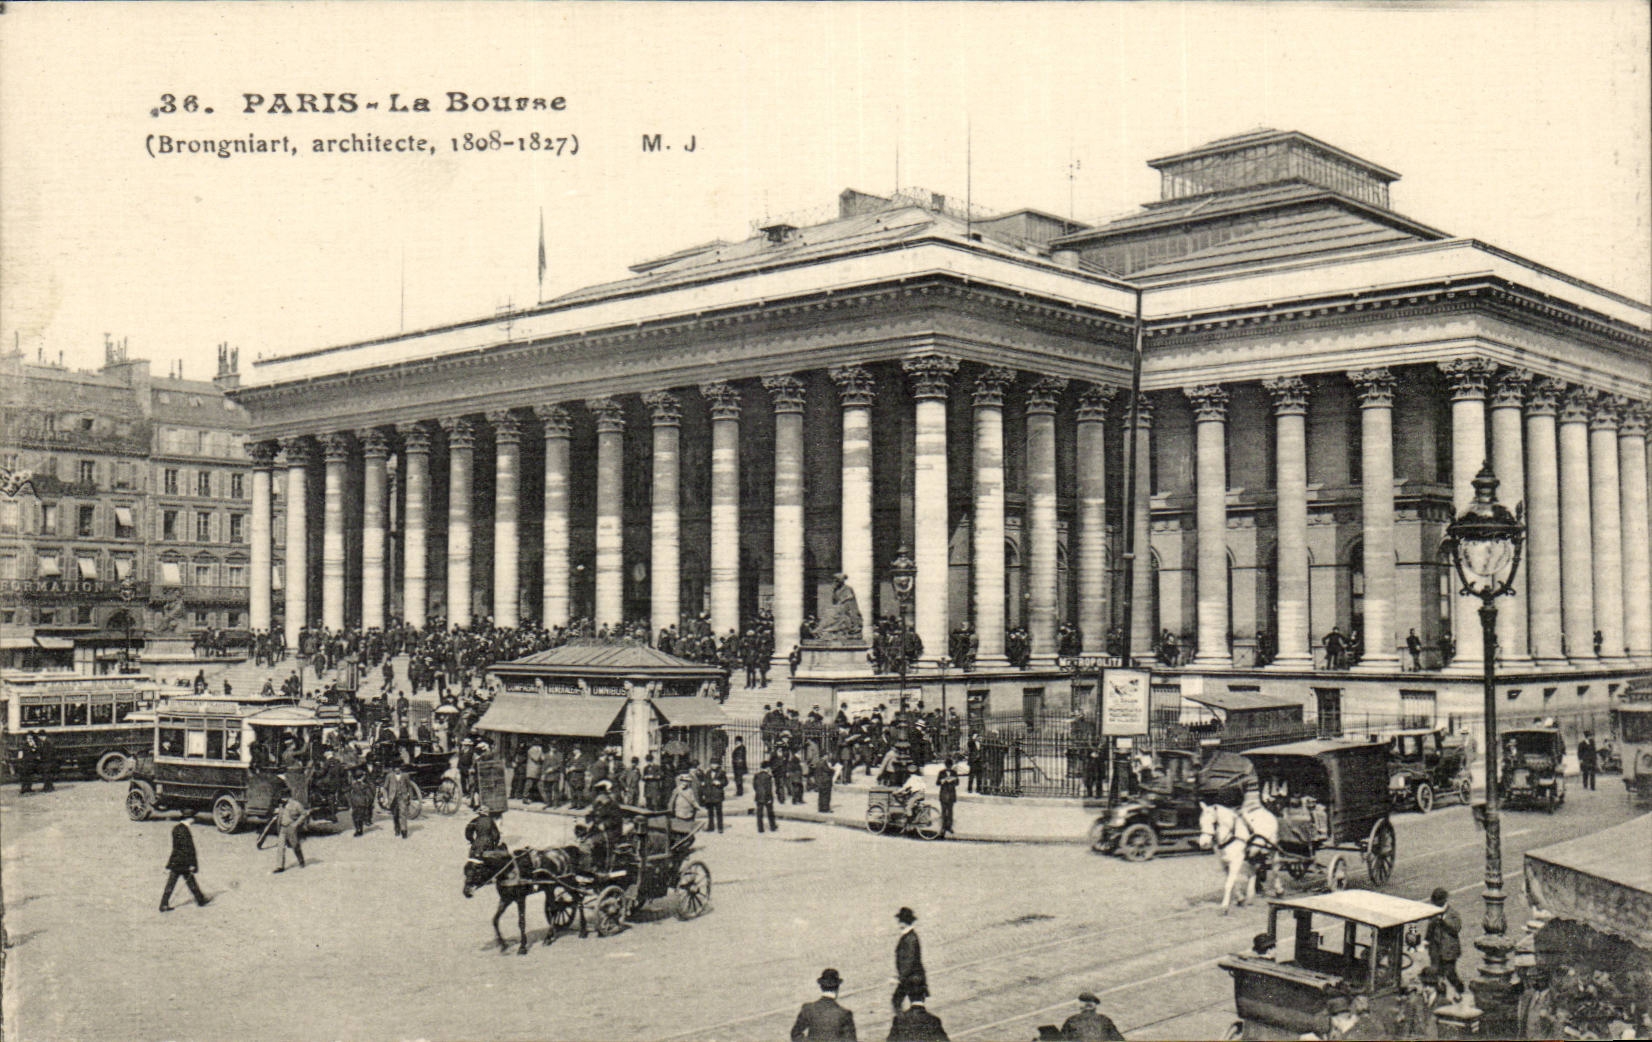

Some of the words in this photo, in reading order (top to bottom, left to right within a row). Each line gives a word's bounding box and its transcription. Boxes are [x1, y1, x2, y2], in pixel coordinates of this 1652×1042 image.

[1058, 657, 1133, 667] METROPOLITA
[508, 684, 537, 694] COMPAGNI
[592, 687, 627, 696] OMNIBUS
